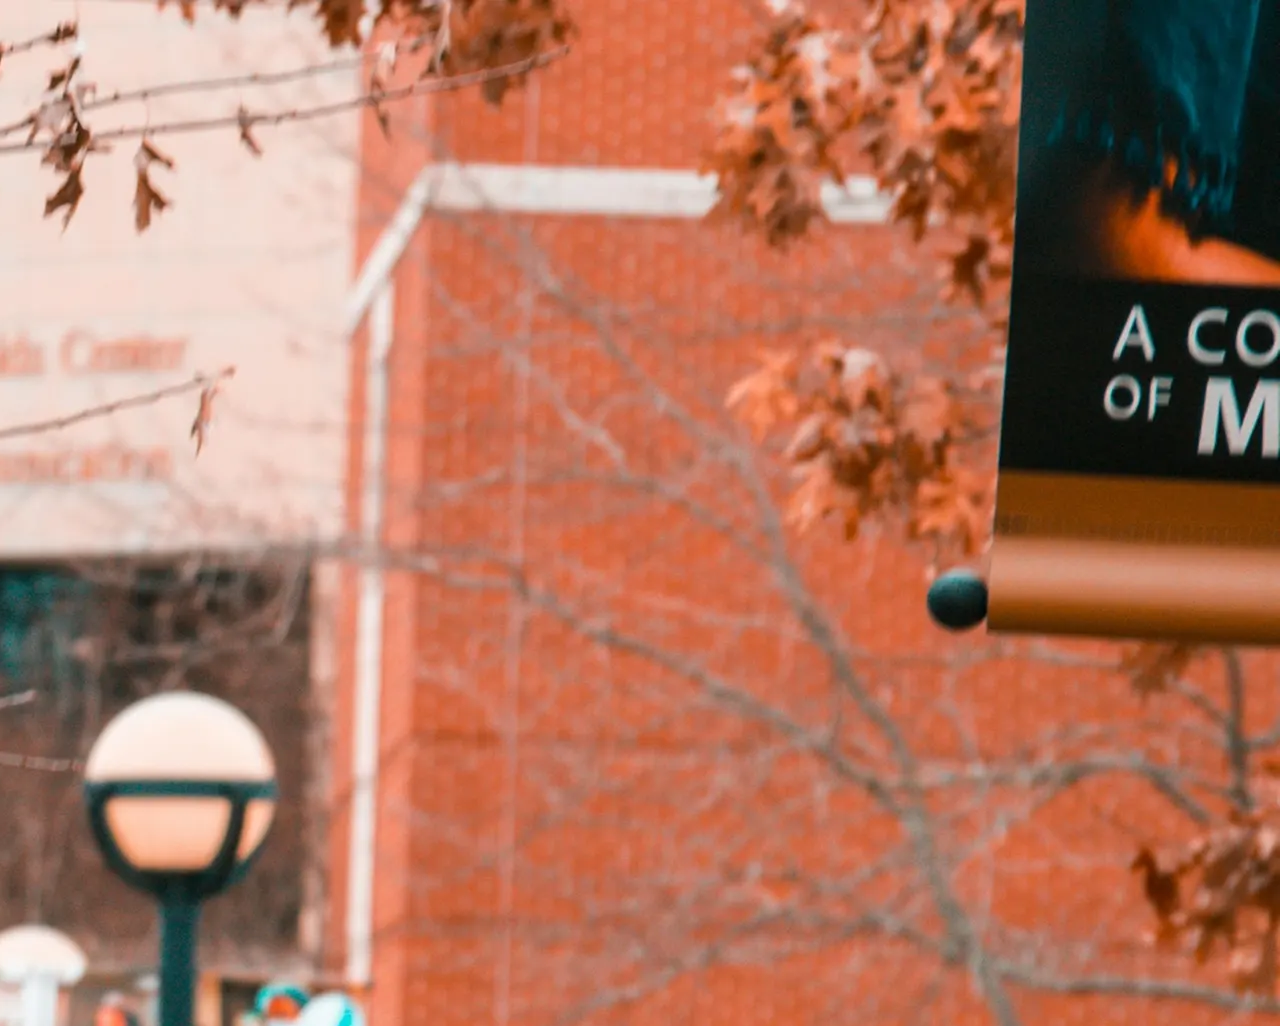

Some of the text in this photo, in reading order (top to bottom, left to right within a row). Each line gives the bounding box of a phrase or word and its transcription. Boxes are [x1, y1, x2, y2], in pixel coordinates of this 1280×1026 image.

[1112, 304, 1156, 362] A
[1103, 373, 1280, 459] OF M
